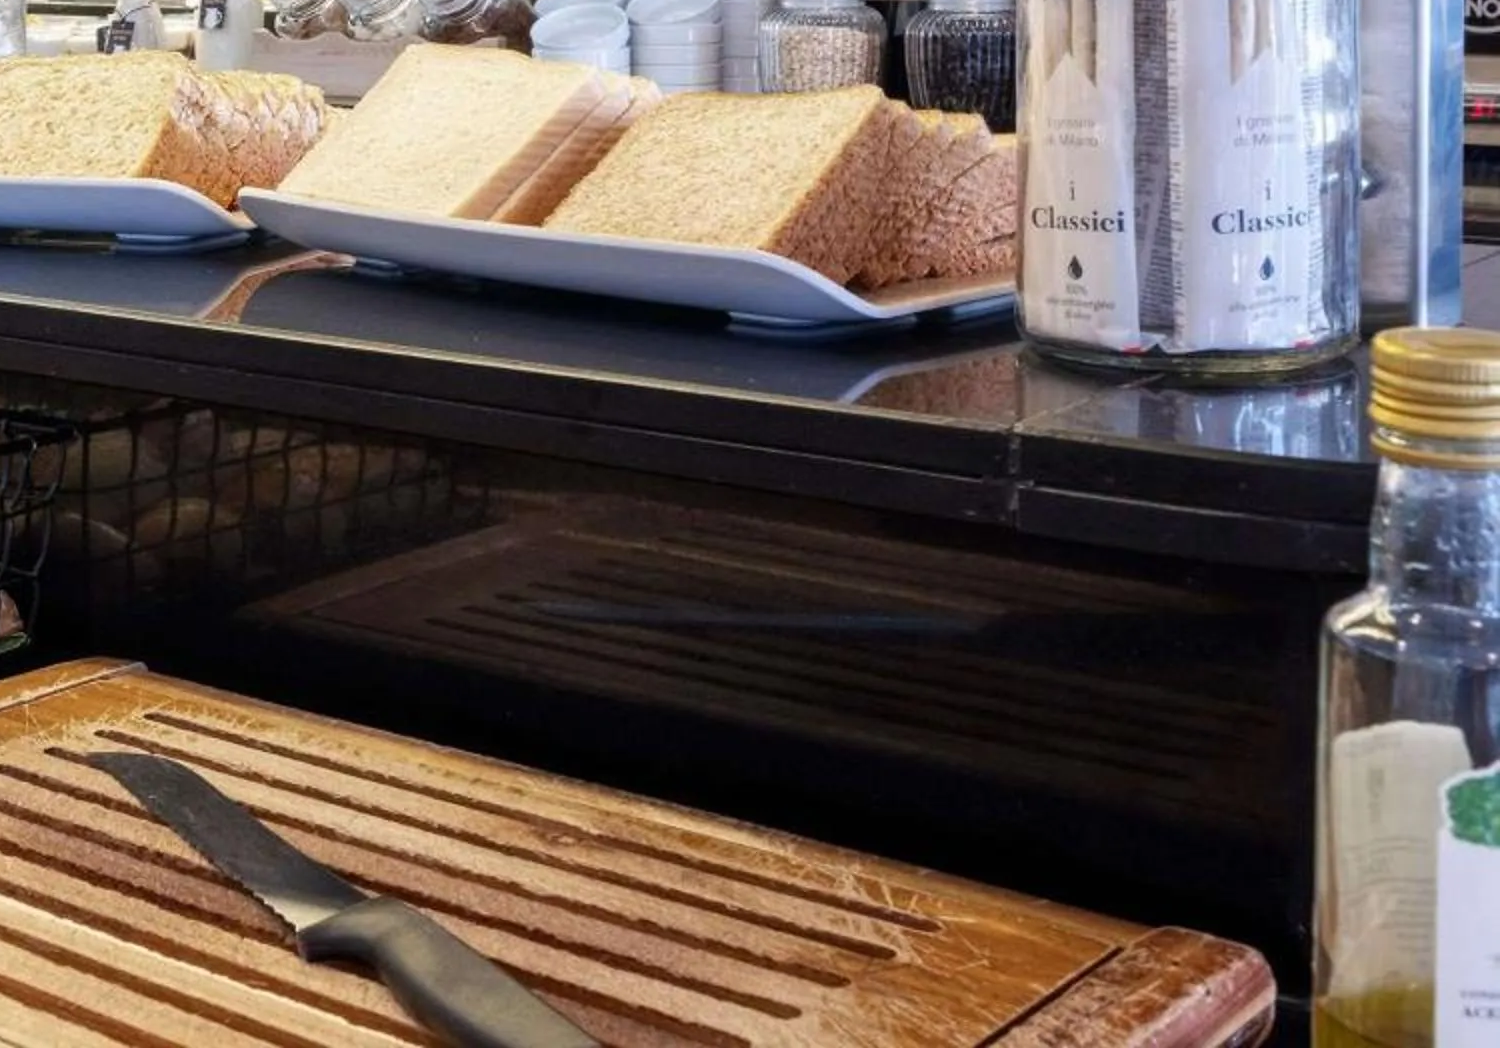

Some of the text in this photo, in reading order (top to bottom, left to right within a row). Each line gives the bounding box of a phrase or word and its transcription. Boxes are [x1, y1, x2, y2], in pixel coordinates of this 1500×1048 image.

[1068, 179, 1076, 201] i
[1263, 178, 1272, 201] i
[1031, 205, 1126, 233] Classici
